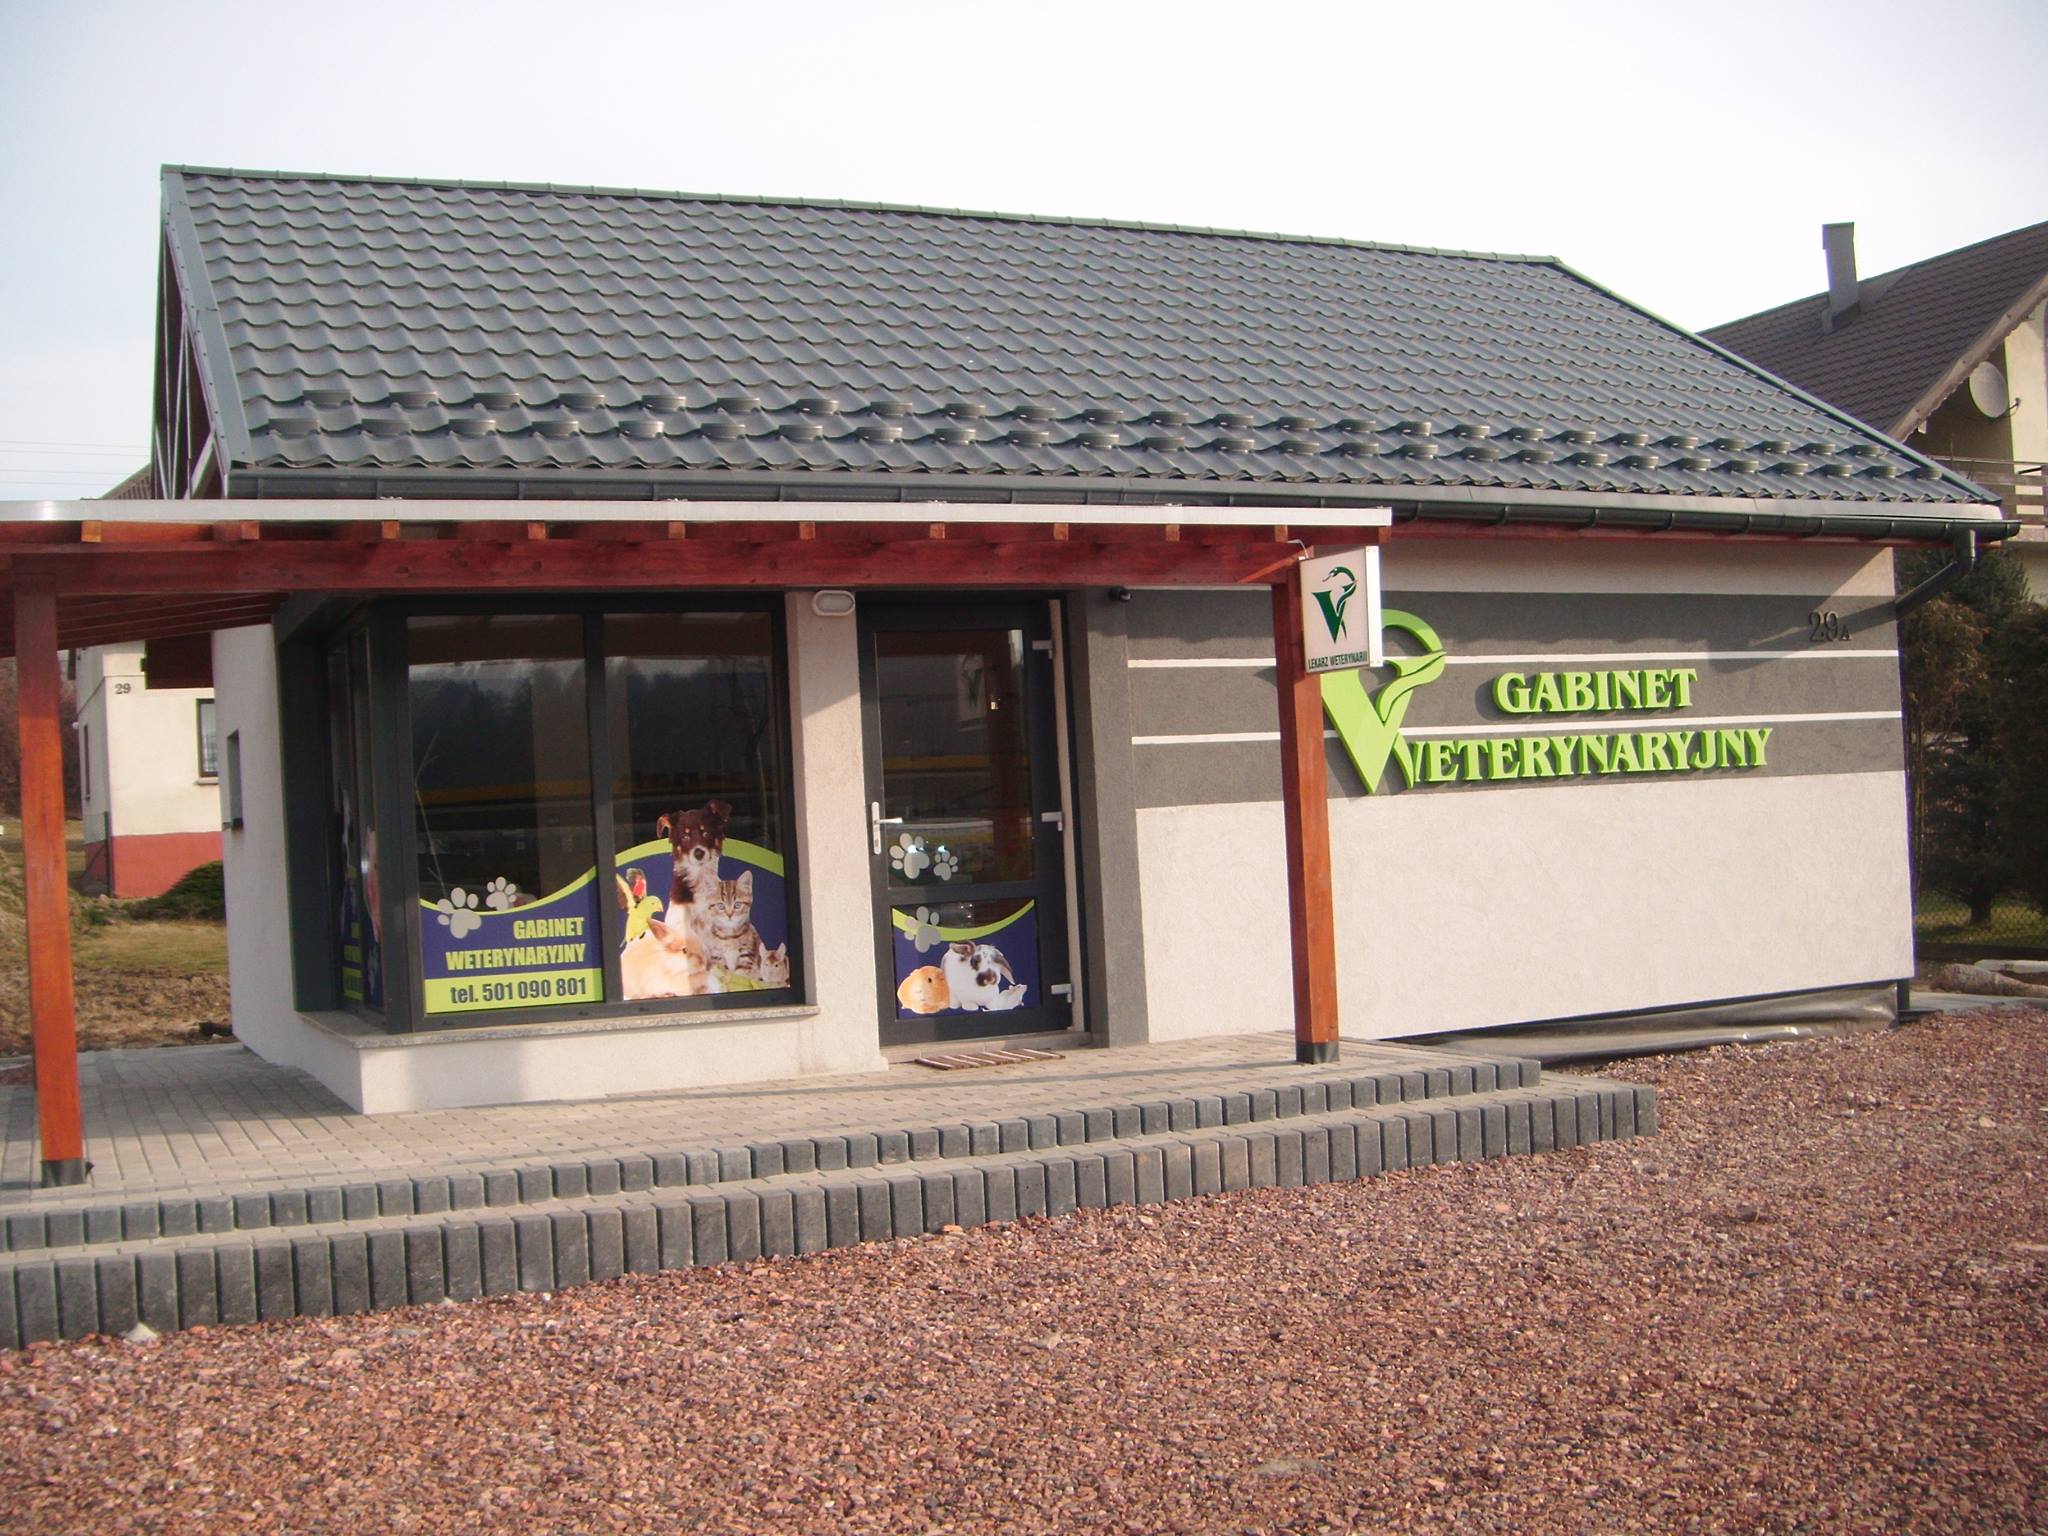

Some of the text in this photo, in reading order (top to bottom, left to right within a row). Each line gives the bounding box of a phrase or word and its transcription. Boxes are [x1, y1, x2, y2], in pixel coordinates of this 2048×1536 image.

[1308, 656, 1329, 670] LEKARZ
[114, 683, 131, 694] 29
[1493, 668, 1698, 715] GABINET
[514, 917, 584, 939] GABINET
[446, 943, 585, 971] WETERYNARYJNY
[451, 976, 587, 1004] tel. 501 090 801
